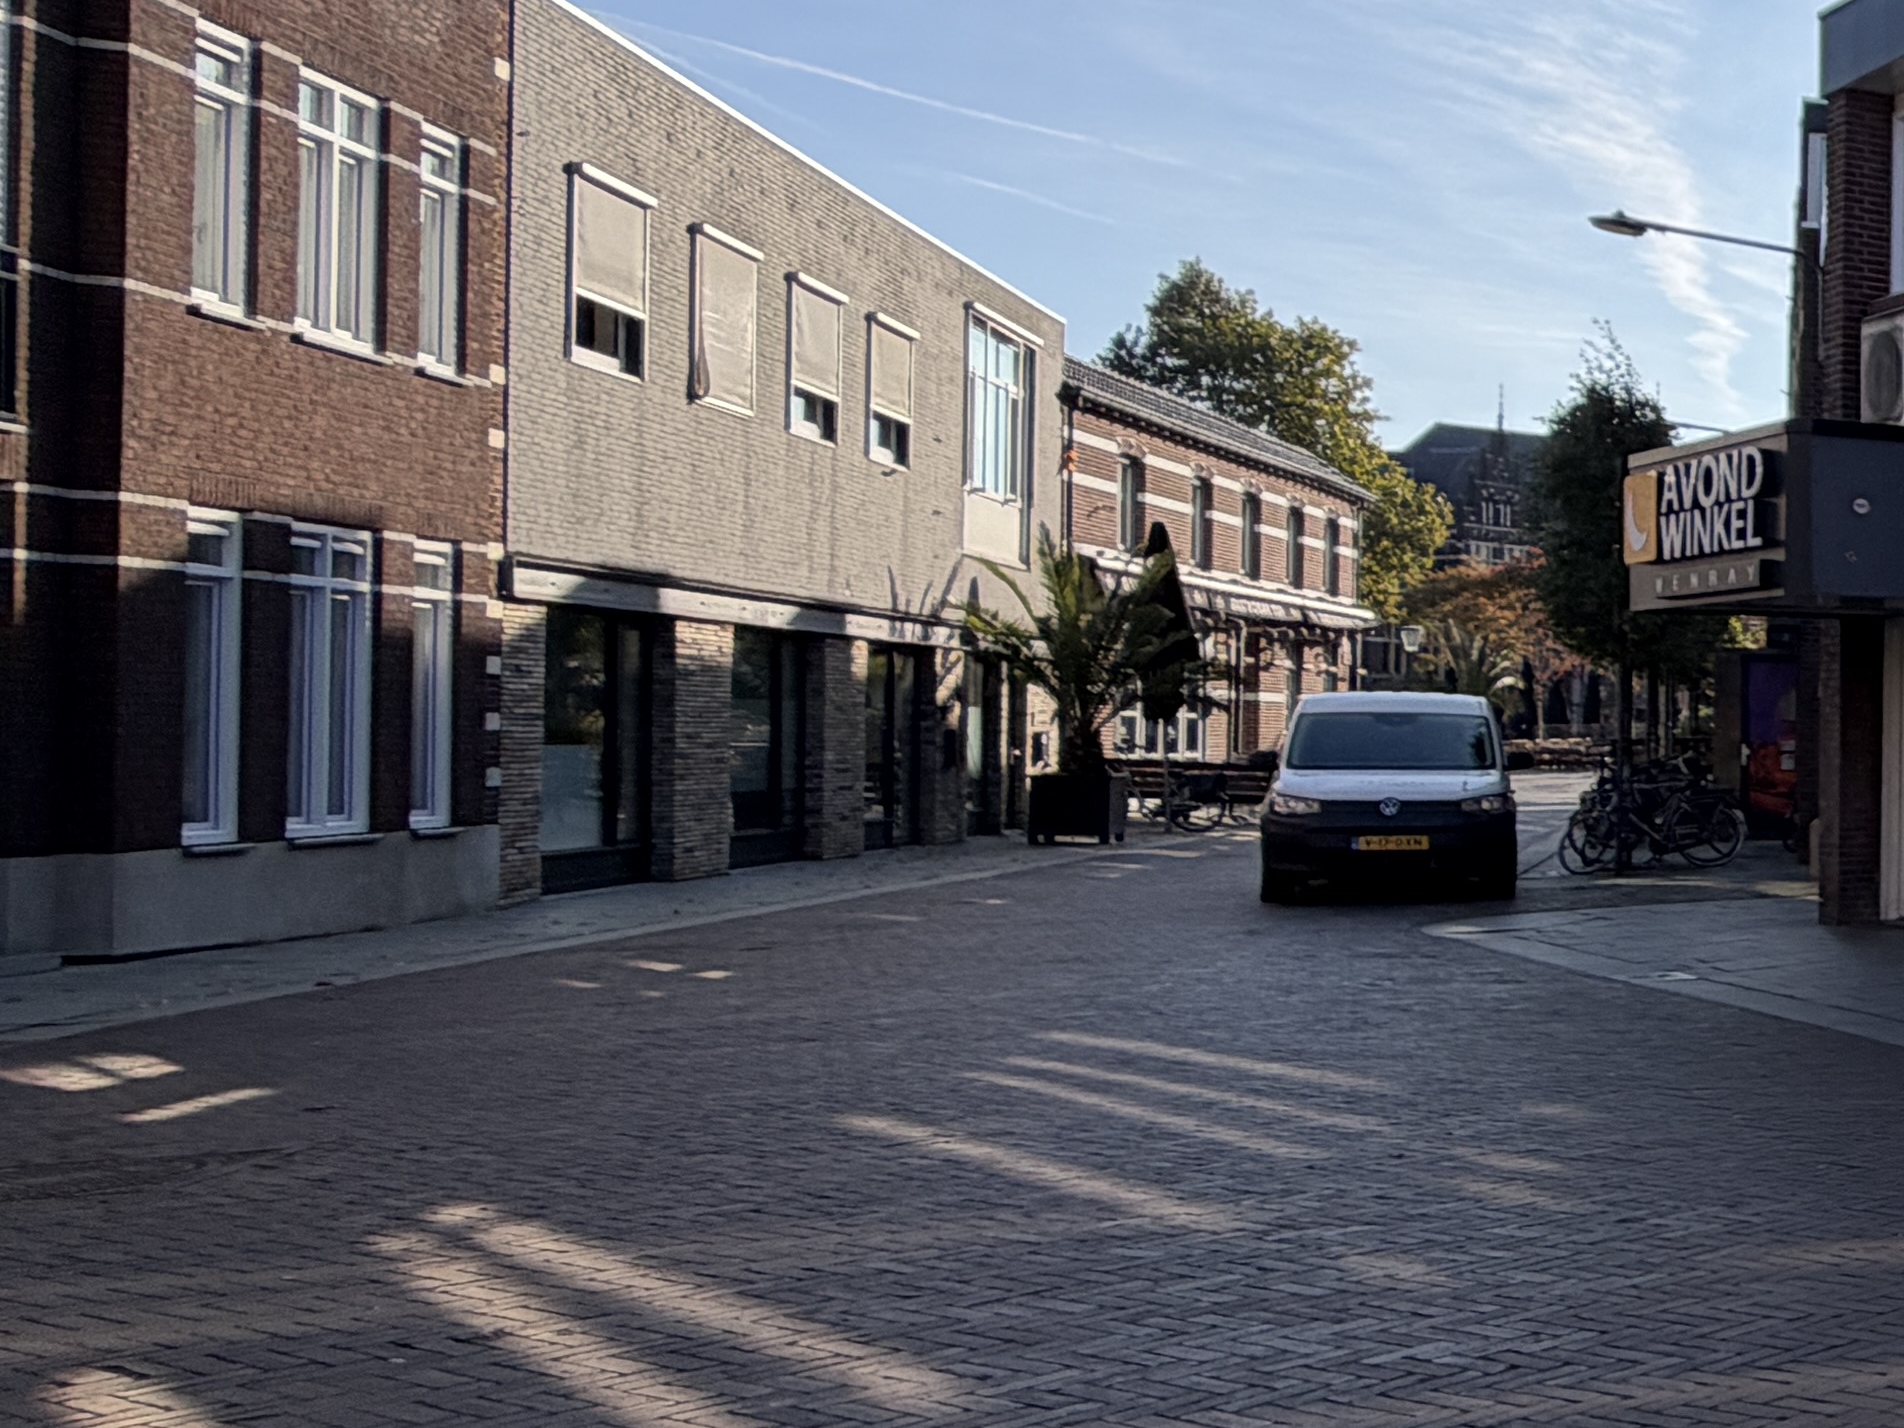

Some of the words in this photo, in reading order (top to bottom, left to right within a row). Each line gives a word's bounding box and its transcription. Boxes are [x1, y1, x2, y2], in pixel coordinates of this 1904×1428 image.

[1659, 445, 1764, 514] AVOND
[1659, 499, 1764, 561] WINKEL
[1655, 564, 1757, 594] VENRAY
